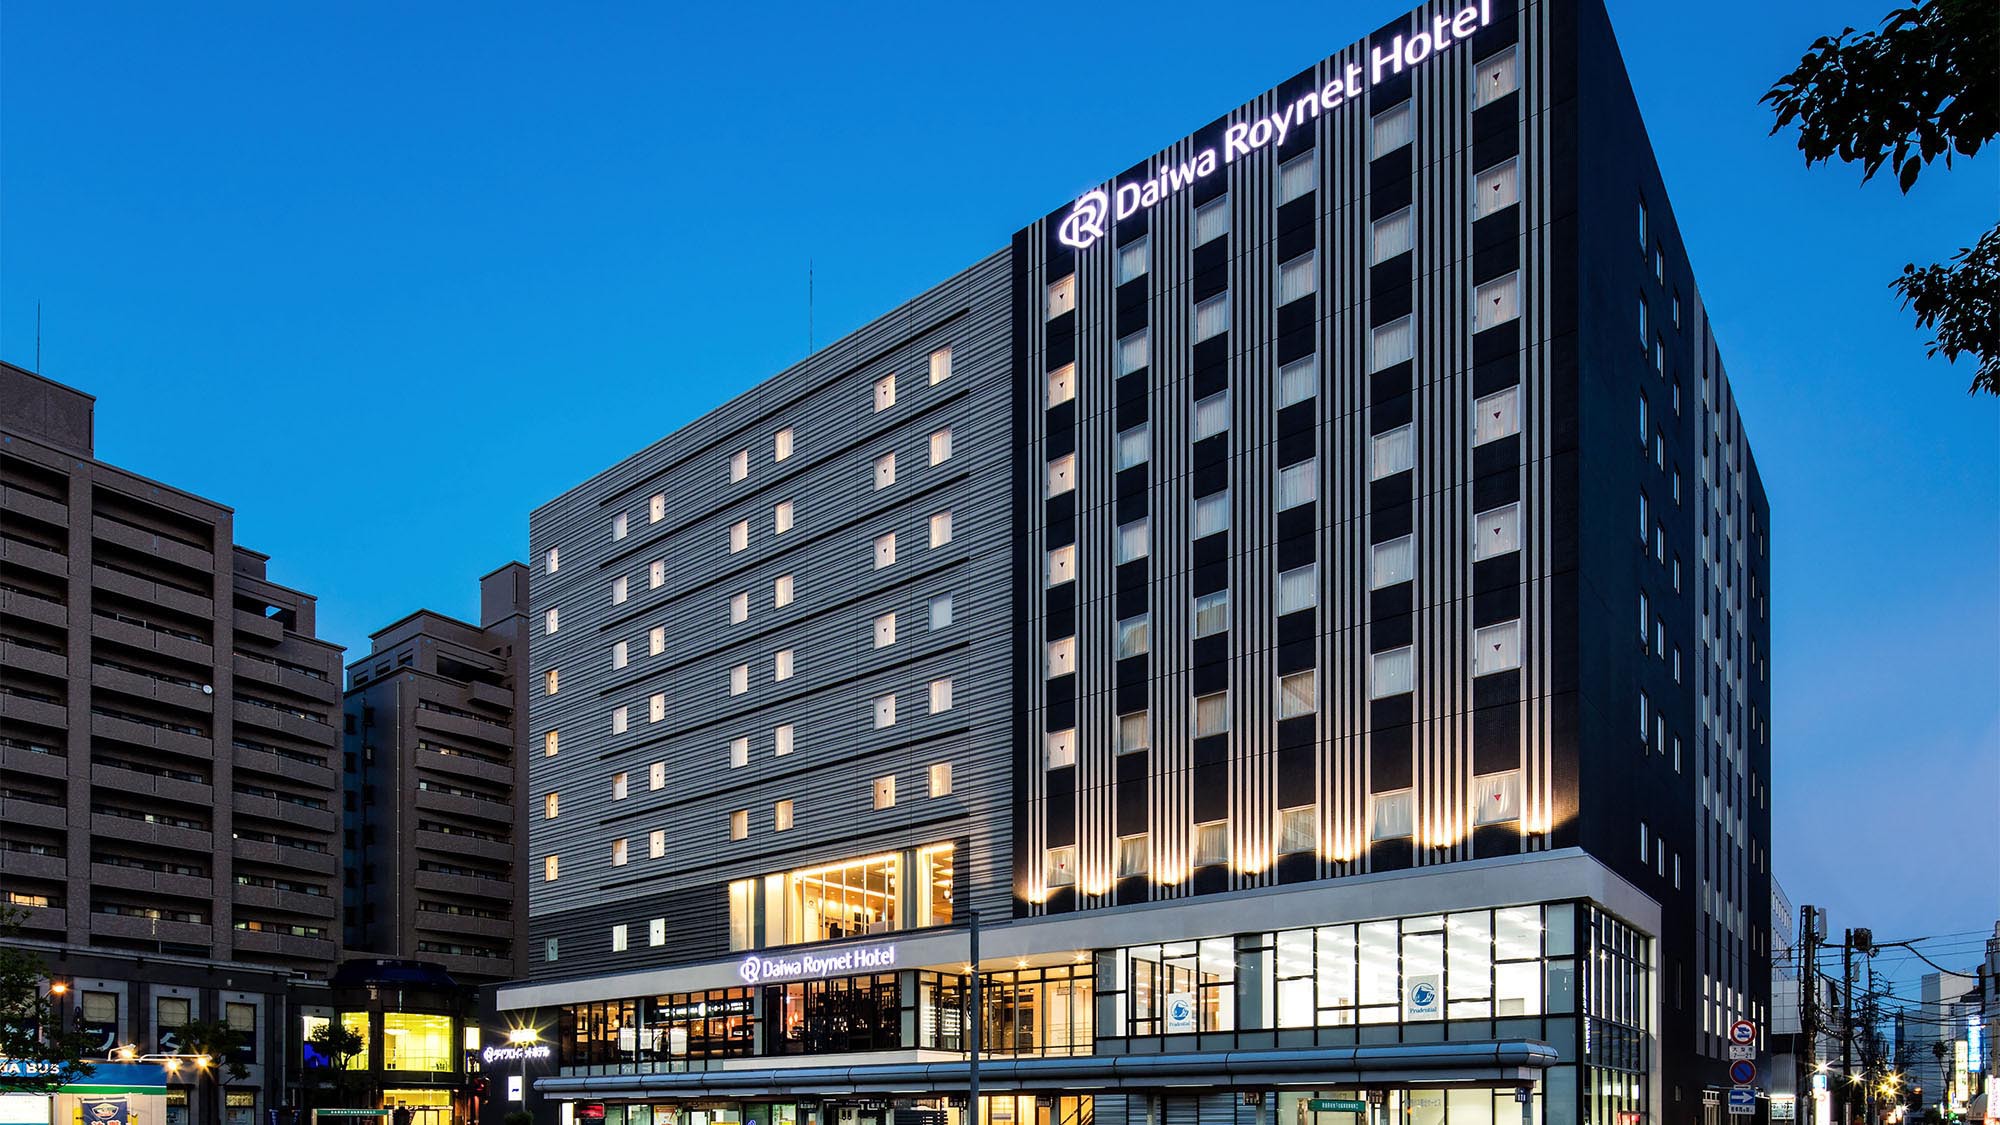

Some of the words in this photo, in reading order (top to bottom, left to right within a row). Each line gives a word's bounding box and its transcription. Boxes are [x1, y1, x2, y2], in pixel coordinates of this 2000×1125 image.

[1116, 149, 1216, 221] Daiwa
[1224, 63, 1362, 163] Roynet
[1372, 0, 1490, 85] Hotel
[763, 959, 802, 978] Daiwa
[803, 952, 853, 977] Roynet
[854, 946, 895, 967] Hotel
[26, 1063, 60, 1074] BUS
